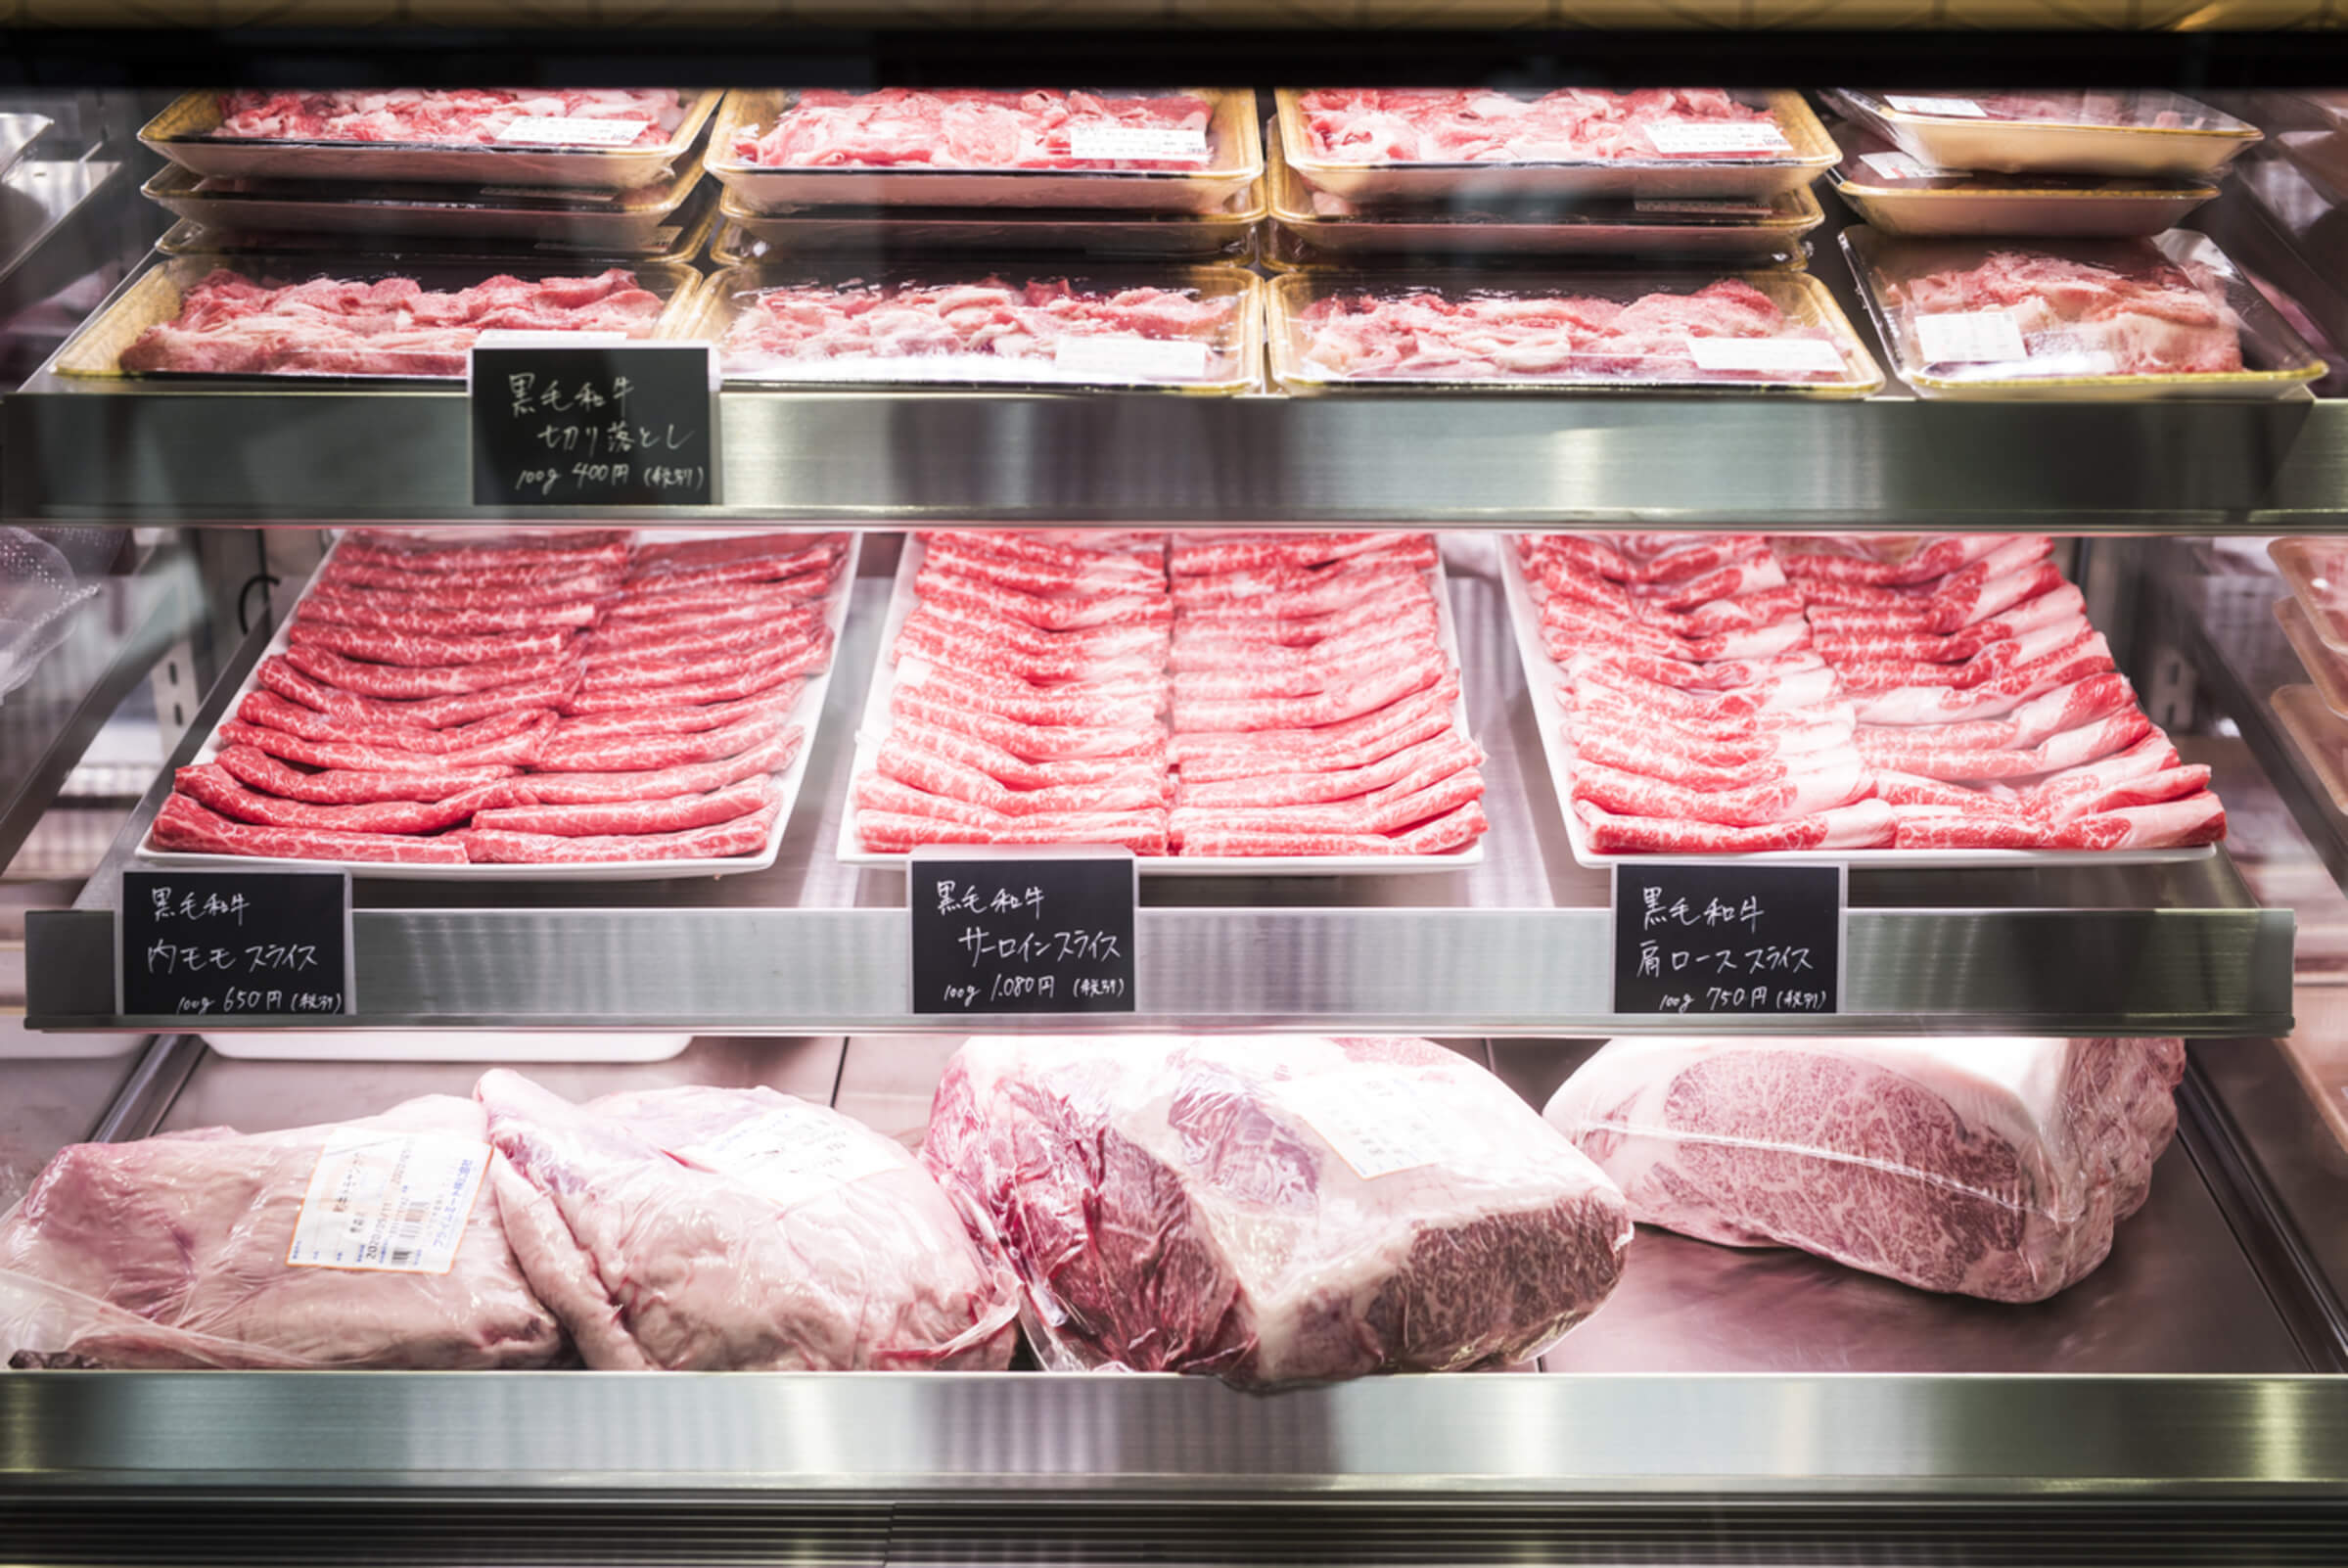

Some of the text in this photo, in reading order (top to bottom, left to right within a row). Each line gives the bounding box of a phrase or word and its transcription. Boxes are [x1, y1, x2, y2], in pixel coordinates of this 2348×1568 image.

[509, 373, 634, 418] 黒毛和牛
[537, 421, 694, 457] 切り落とし
[515, 469, 561, 495] 100g
[572, 462, 629, 488] 400円
[152, 887, 251, 926] 黒毛和牛
[937, 880, 1044, 920] 黒毛和牛
[1642, 886, 1765, 933] 黒毛和牛
[147, 938, 318, 975] 内モモ スライス
[1636, 940, 1813, 978] 肩ロース スライス
[175, 995, 215, 1016] 100g
[223, 987, 283, 1012] 650円
[944, 984, 982, 1007] 100g
[1659, 992, 1695, 1014] 100g
[1706, 986, 1768, 1011] 750円
